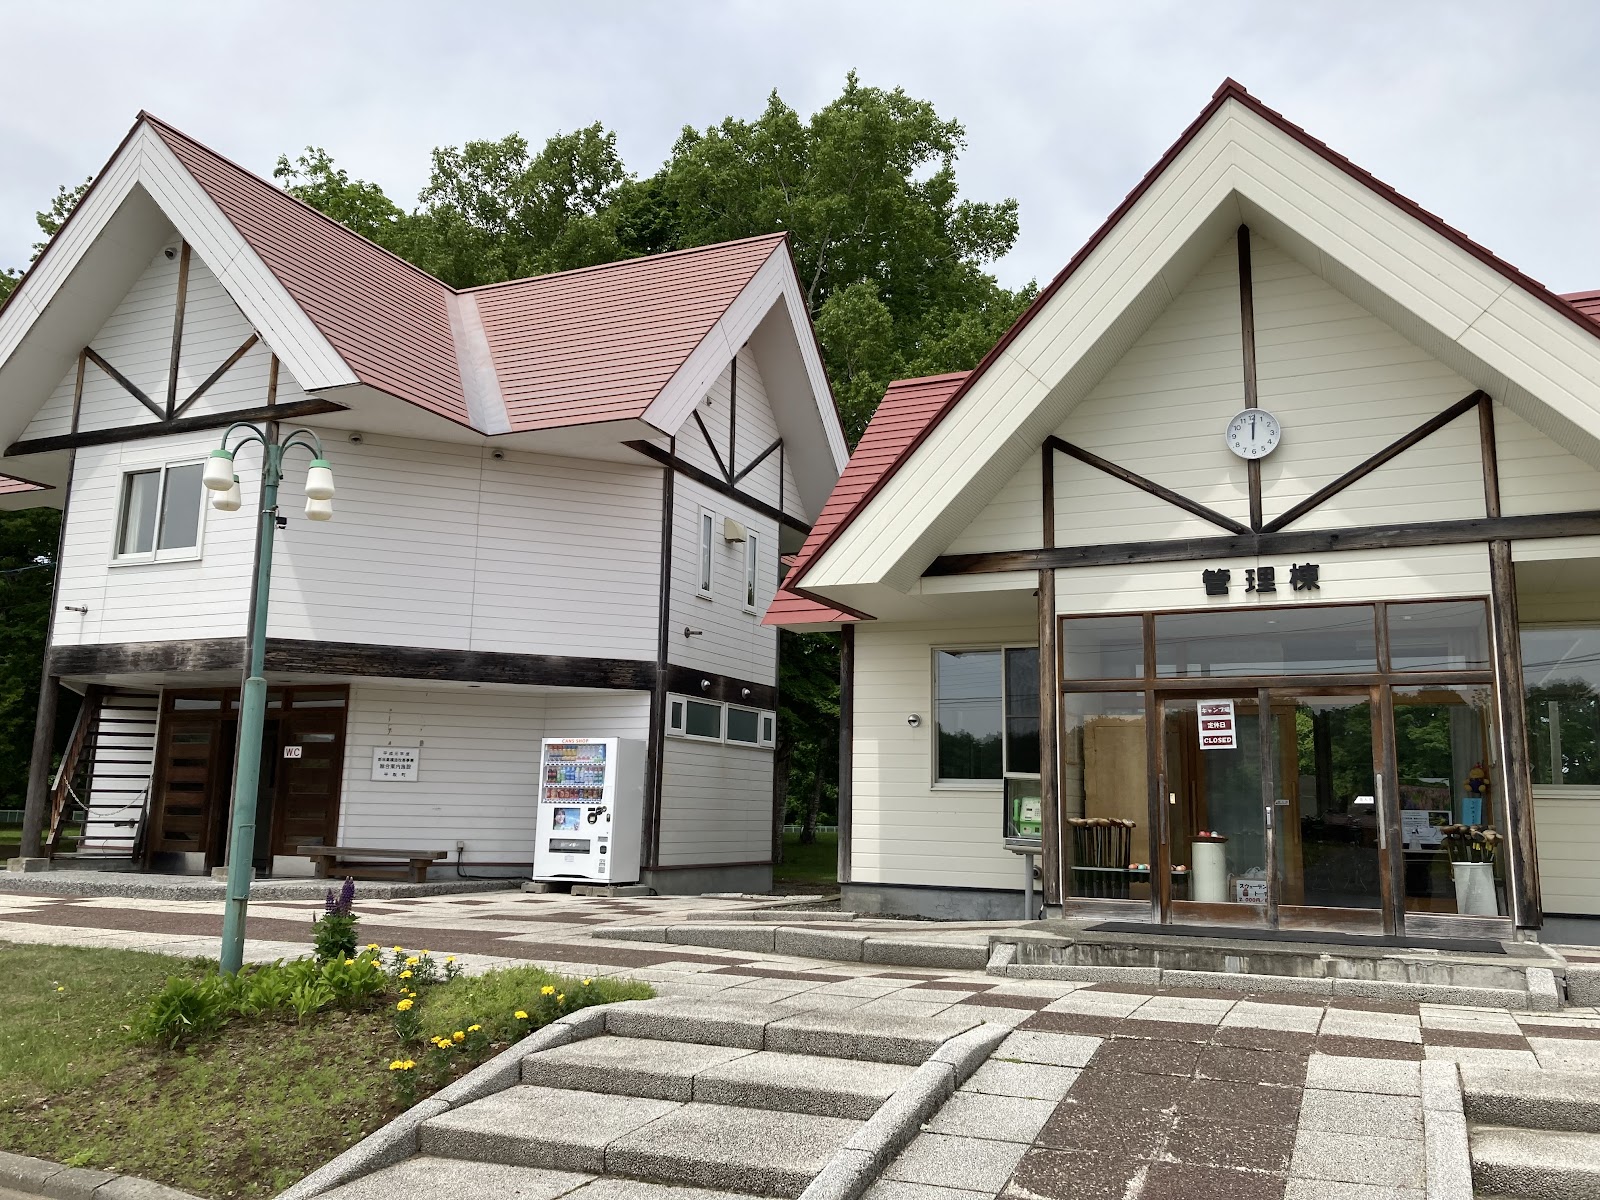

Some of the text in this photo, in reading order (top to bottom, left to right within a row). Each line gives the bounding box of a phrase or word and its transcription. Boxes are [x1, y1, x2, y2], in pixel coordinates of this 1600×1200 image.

[1202, 562, 1321, 596] 管理棟
[1207, 721, 1226, 729] 定休日
